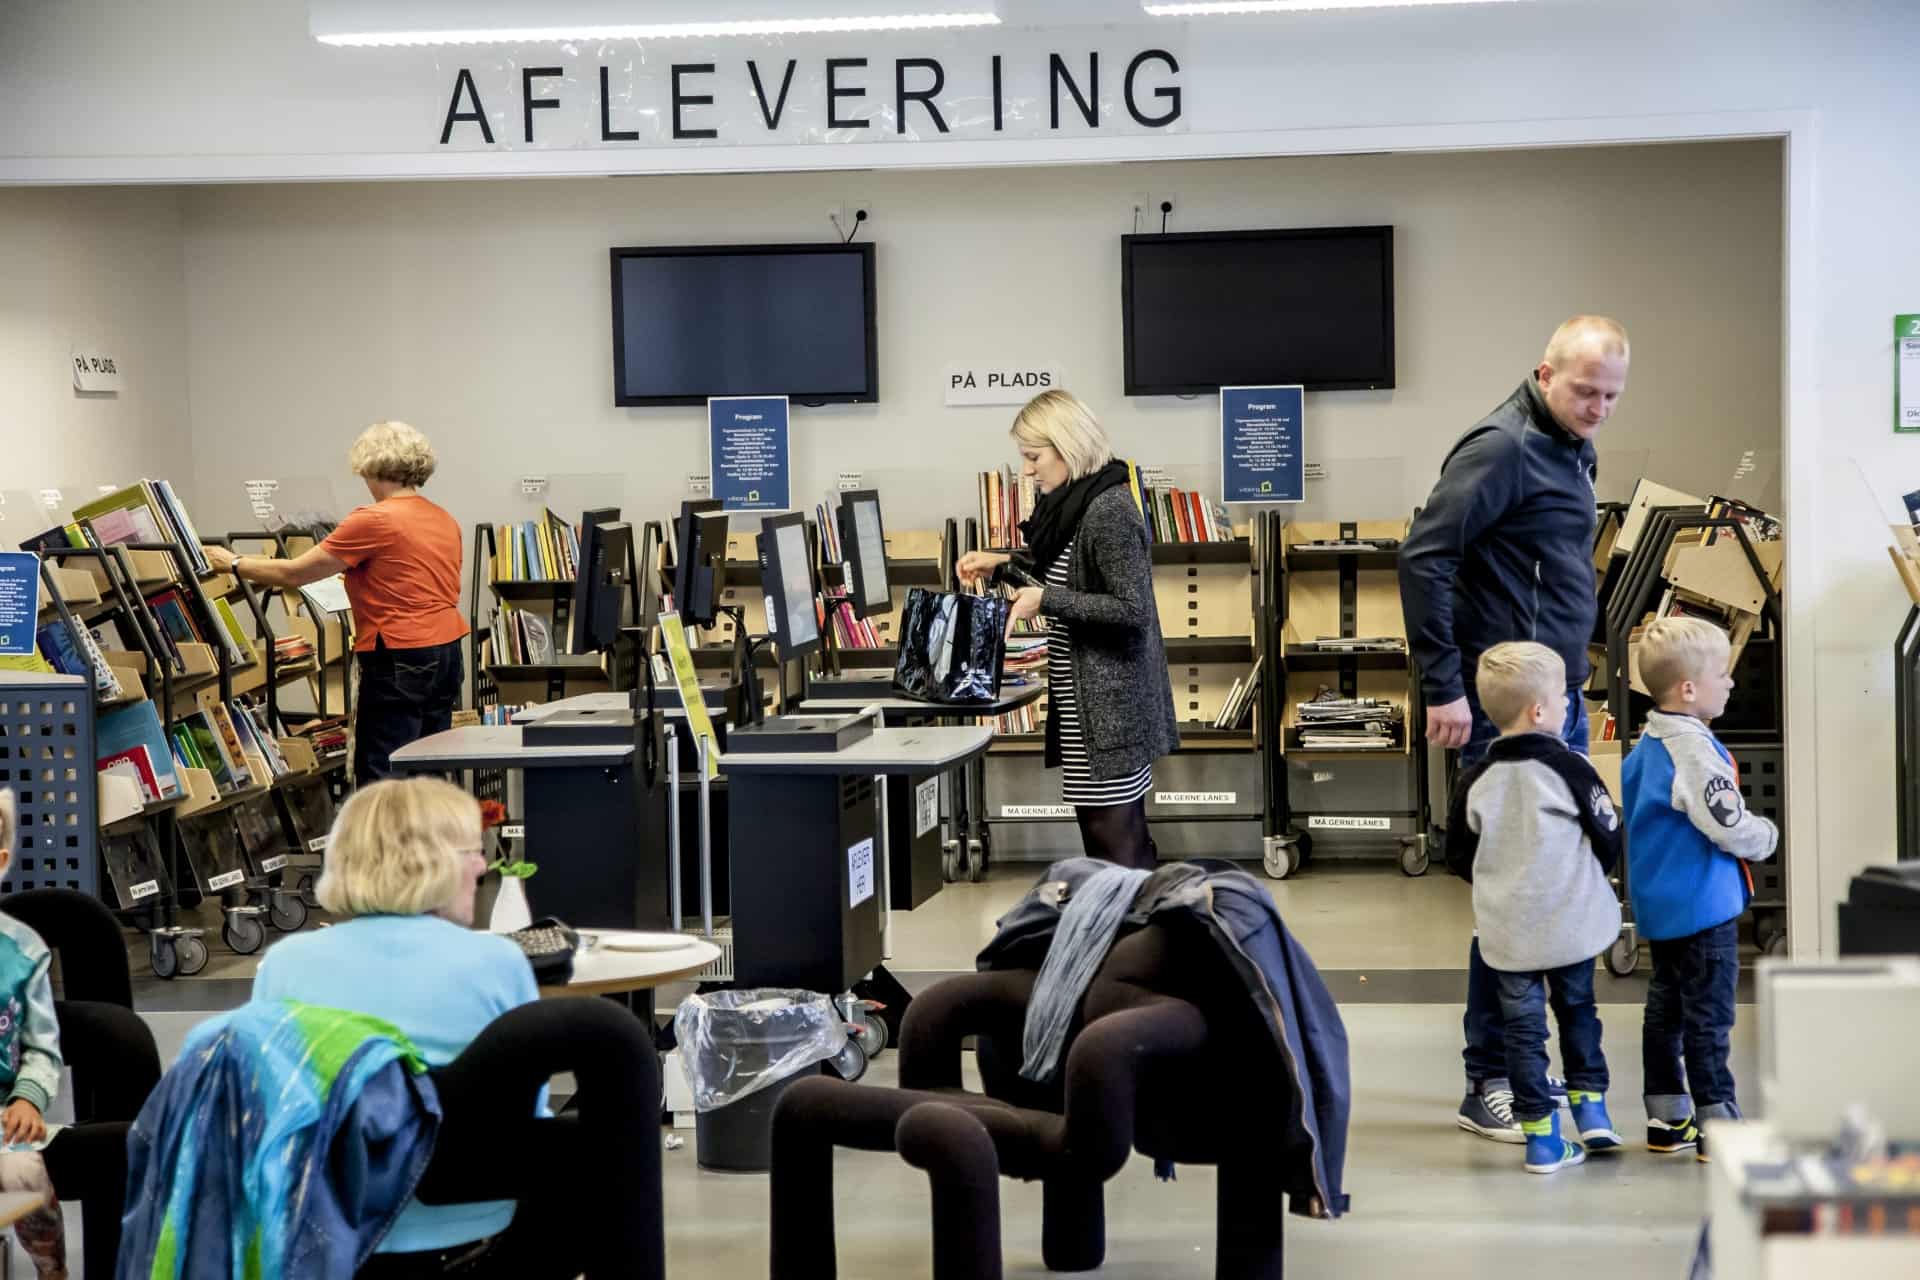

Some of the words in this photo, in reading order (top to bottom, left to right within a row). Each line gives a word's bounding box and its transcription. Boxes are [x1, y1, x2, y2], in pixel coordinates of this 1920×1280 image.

[440, 48, 1182, 145] AFLEVERING
[951, 371, 977, 389] PÅ
[988, 372, 1052, 388] PLADS
